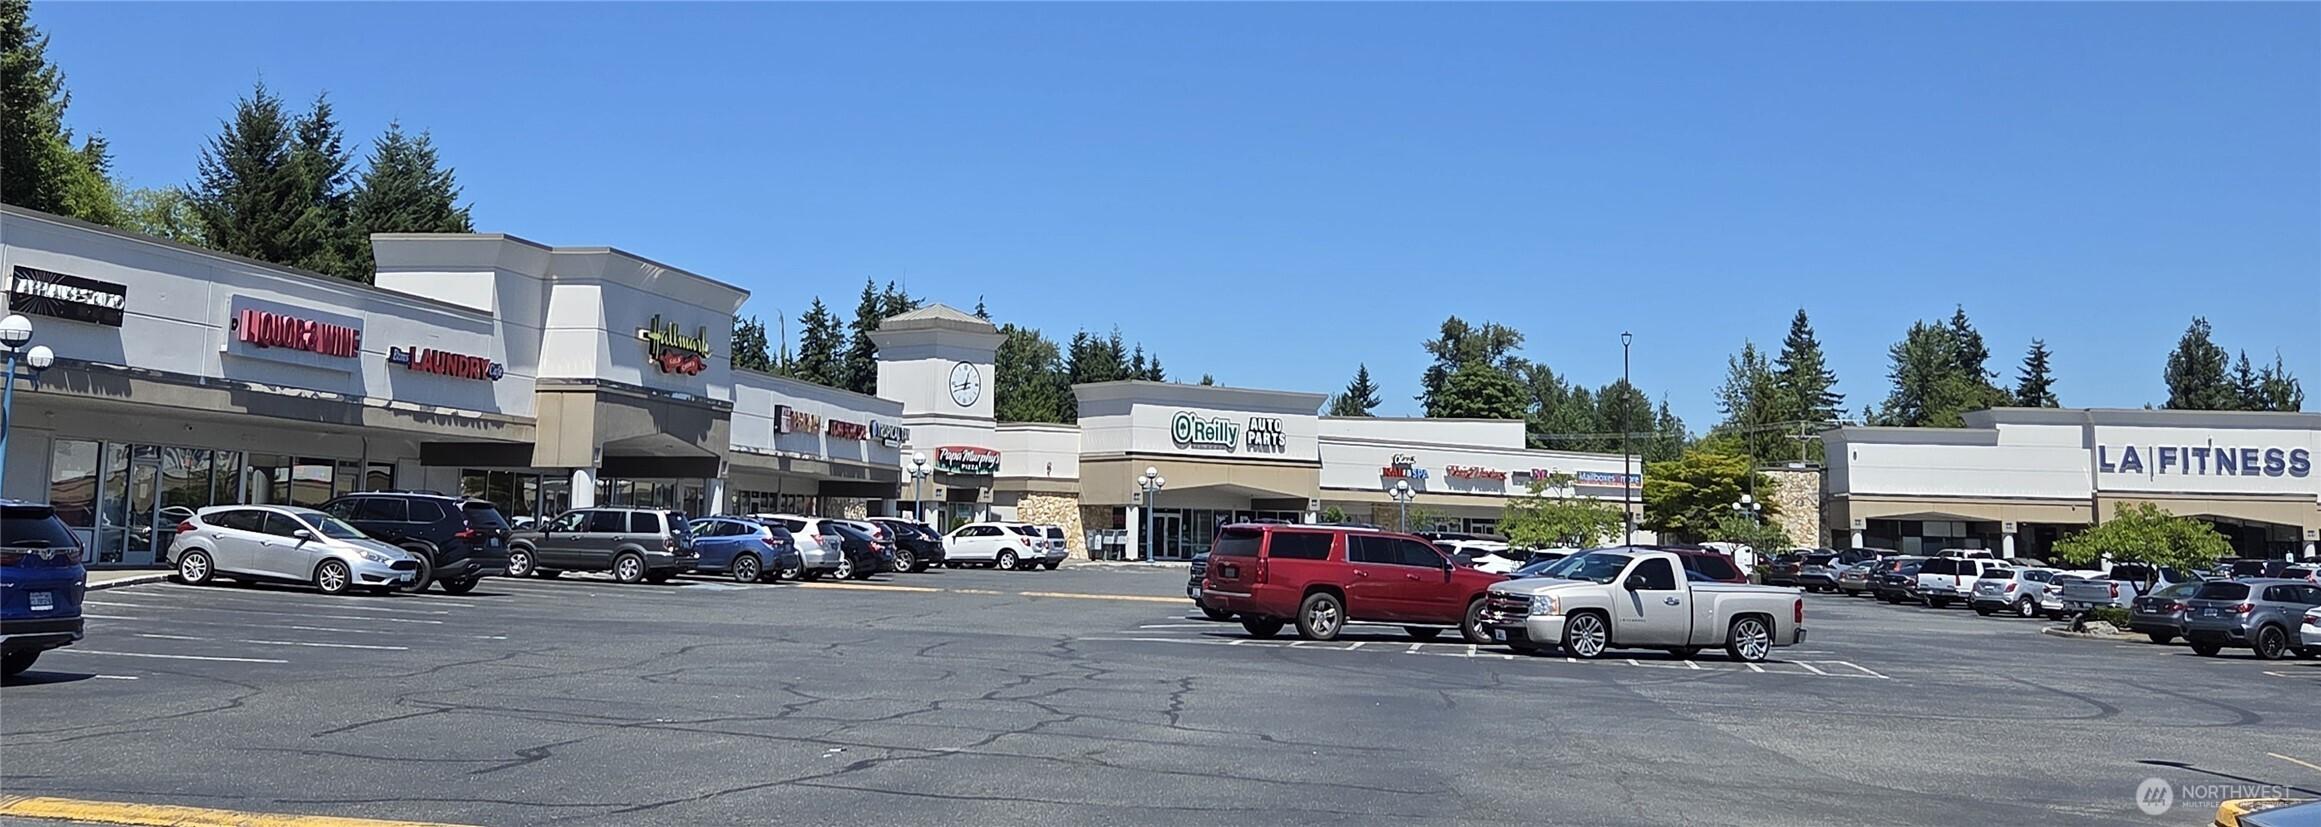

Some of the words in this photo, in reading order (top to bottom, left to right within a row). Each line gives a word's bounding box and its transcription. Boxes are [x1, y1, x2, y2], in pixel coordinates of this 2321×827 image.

[317, 323, 360, 358] WINE
[648, 314, 712, 359] Hallmark
[408, 346, 491, 380] LAUNDRY
[1174, 414, 1238, 446] O'Reilly
[1247, 431, 1287, 446] PARTS
[1249, 417, 1282, 432] AUTO
[940, 448, 962, 467] Papa
[961, 463, 979, 471] PIZZA
[2099, 445, 2143, 473] LA
[2159, 446, 2311, 476] FITNESS
